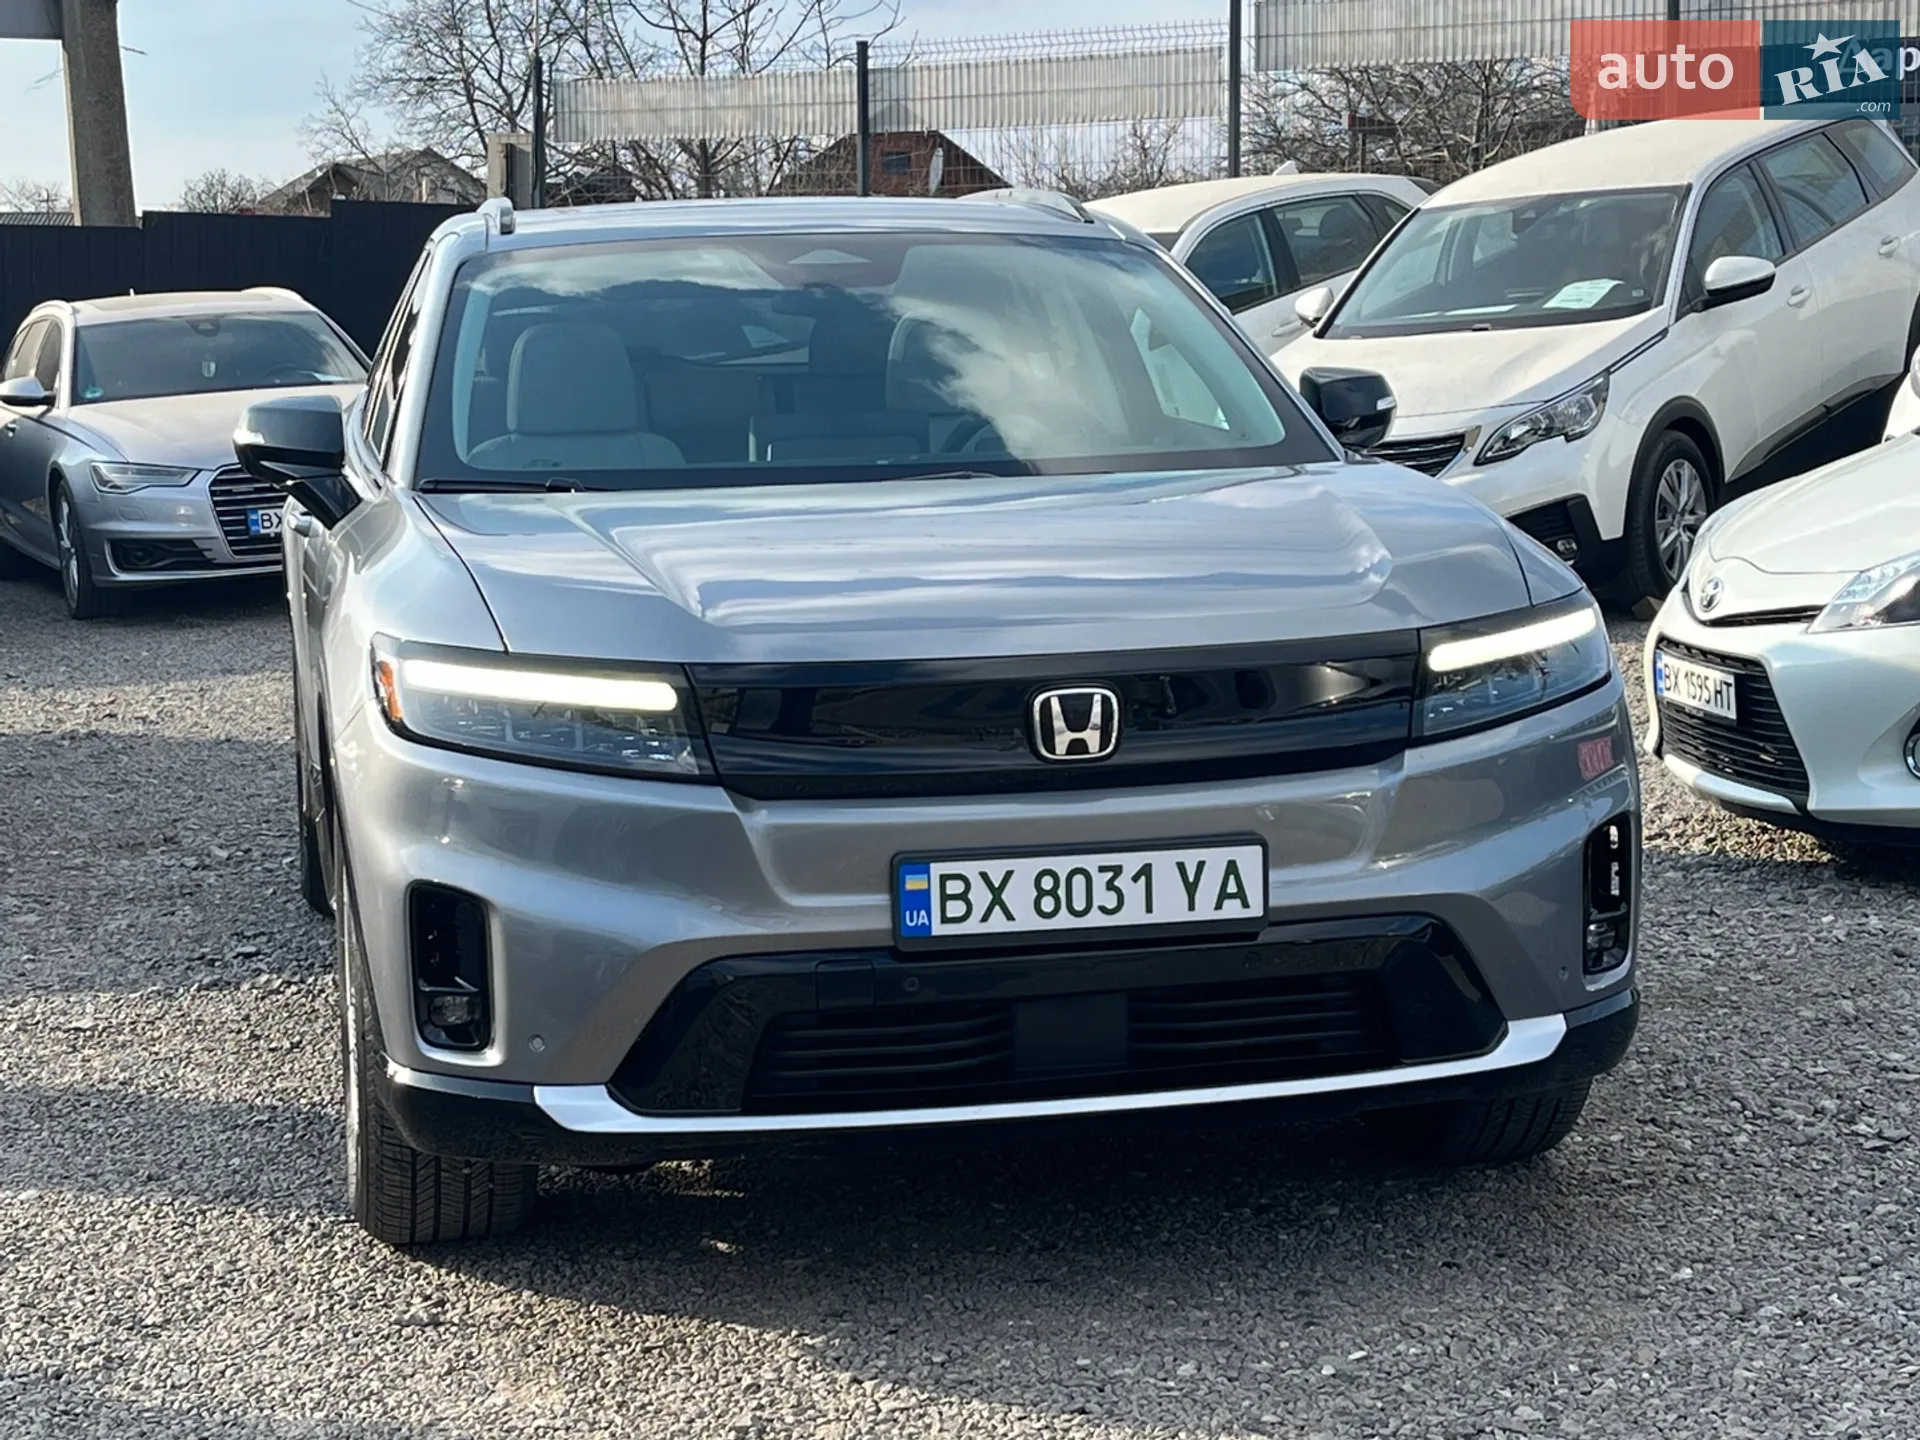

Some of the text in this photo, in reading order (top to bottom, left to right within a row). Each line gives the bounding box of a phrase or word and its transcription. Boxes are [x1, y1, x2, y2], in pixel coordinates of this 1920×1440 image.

[1664, 663, 1732, 711] BX 1595 HT
[938, 859, 1251, 925] BX 8031 YA
[905, 911, 929, 928] UA
